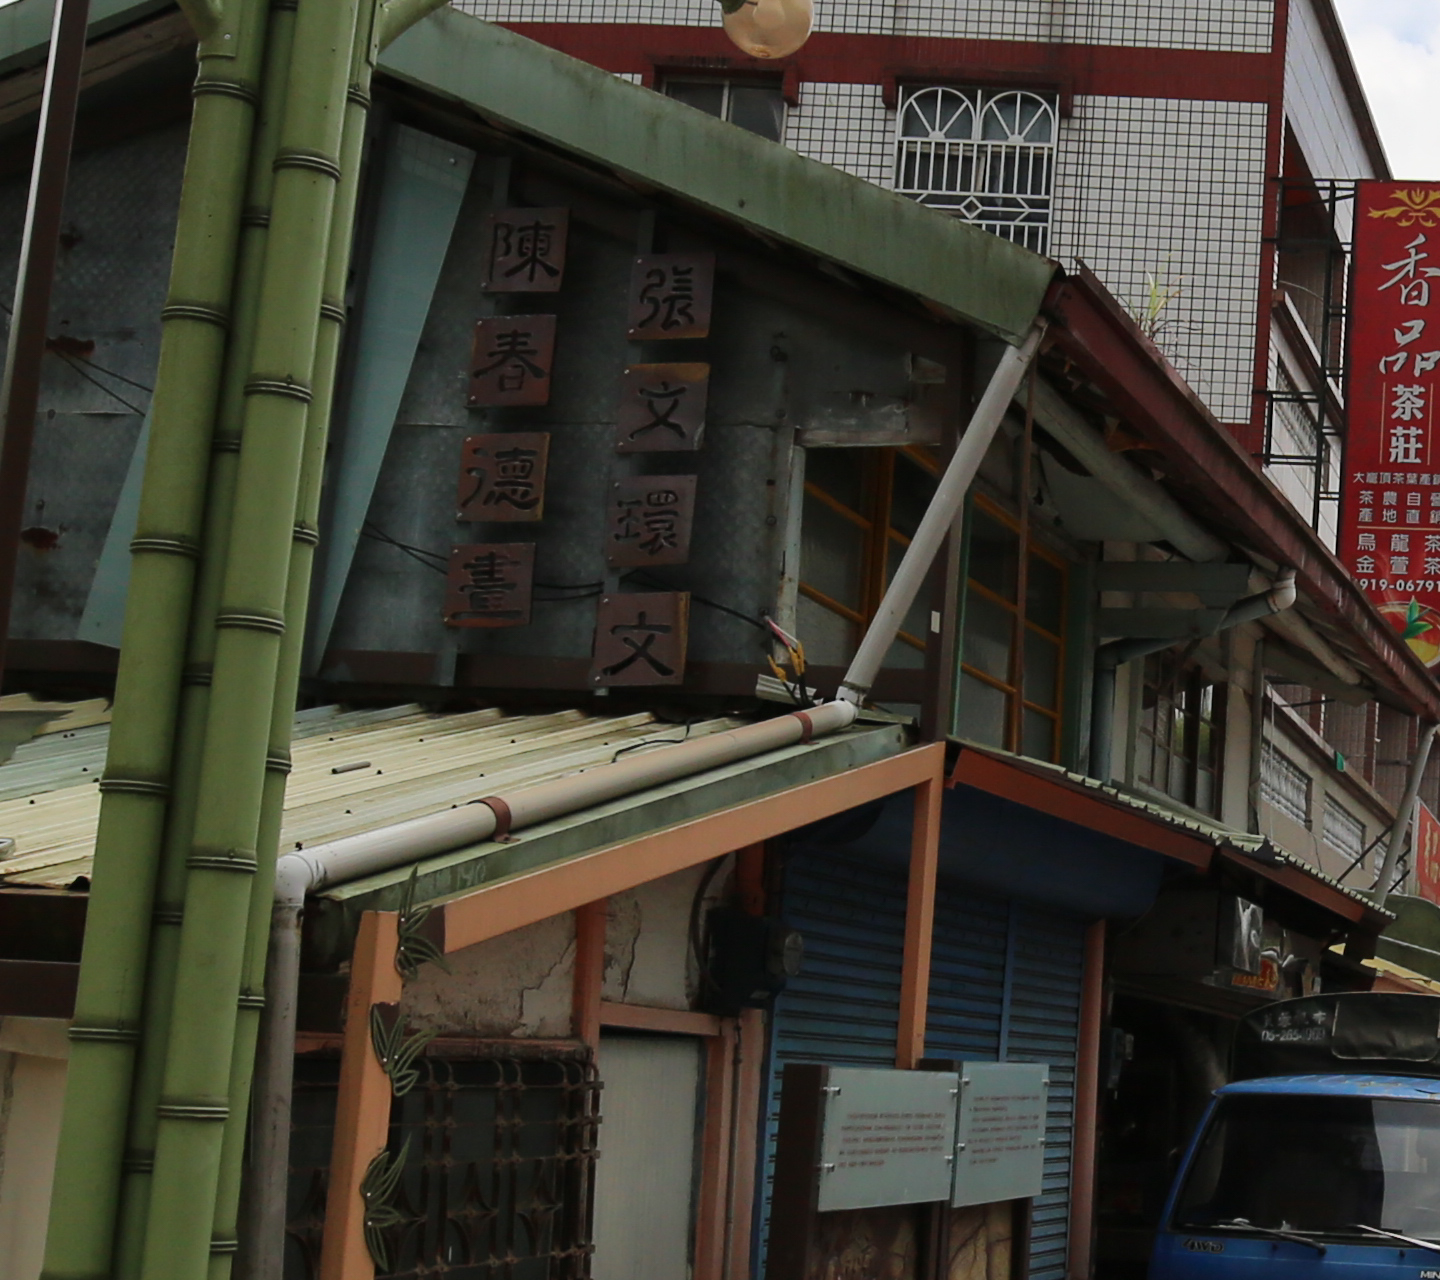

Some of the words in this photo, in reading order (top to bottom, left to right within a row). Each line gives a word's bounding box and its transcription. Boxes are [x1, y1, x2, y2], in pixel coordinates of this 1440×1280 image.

[602, 266, 695, 677] 張文環文
[1182, 1237, 1224, 1253] 4WD
